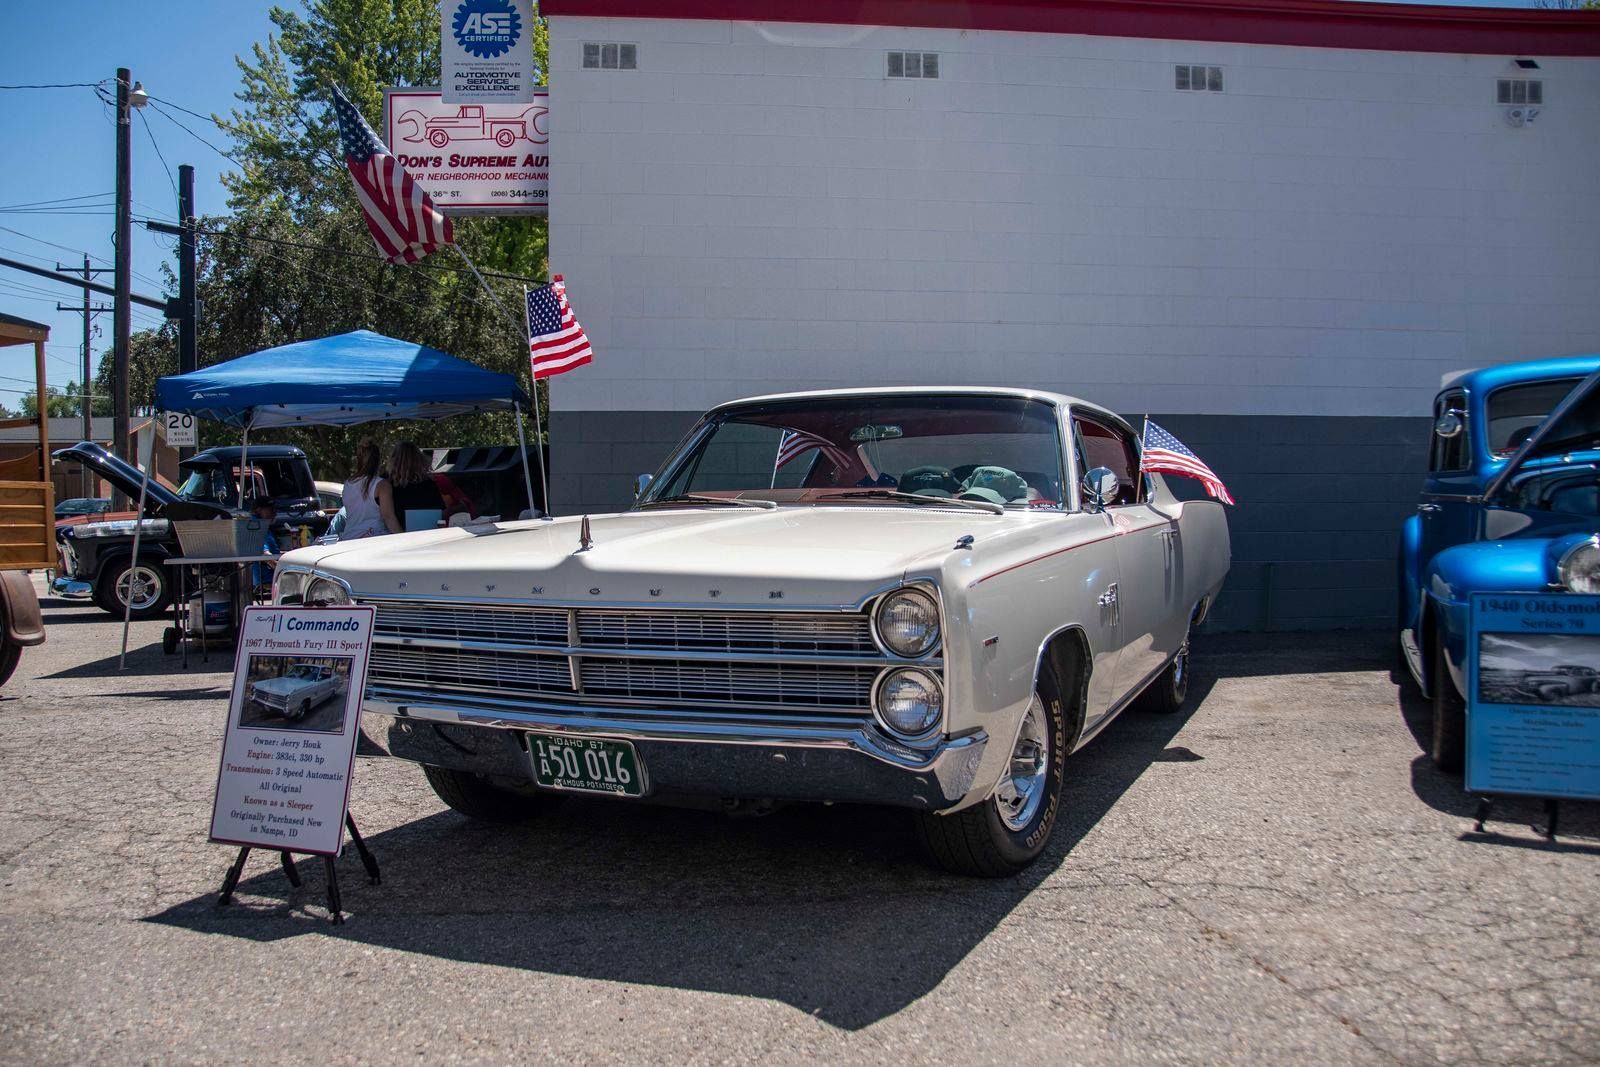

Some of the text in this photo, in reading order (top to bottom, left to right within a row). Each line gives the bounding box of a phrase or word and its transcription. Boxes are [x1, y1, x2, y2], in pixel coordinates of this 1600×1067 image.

[461, 12, 511, 34] ASE
[398, 154, 443, 168] DON'S
[448, 154, 517, 168] SUPREME
[427, 172, 501, 181] NEIGHBORHOOD
[450, 190, 462, 198] ST.
[169, 415, 193, 429] 20
[398, 581, 784, 599] PLYMOUTH
[1479, 599, 1520, 613] 1940
[286, 617, 360, 632] Commando
[1520, 618, 1564, 630] Series
[245, 638, 363, 651] 1967 Plymouth Fury III Sport
[253, 736, 279, 746] Owner:
[281, 738, 300, 749] Jerry
[553, 737, 604, 750] IDAHO 67
[1051, 700, 1063, 782] SPORT
[247, 749, 325, 765] Engine: 383ci, 330 hp
[548, 744, 631, 784] 50 016
[225, 763, 344, 781] Transmission: 3 Speed Automatic
[259, 781, 302, 793] All Original
[243, 795, 268, 806] Known
[286, 800, 314, 811] Sleeper
[230, 809, 323, 827] Originally Purchased New
[250, 823, 299, 837] in Nampa, ID
